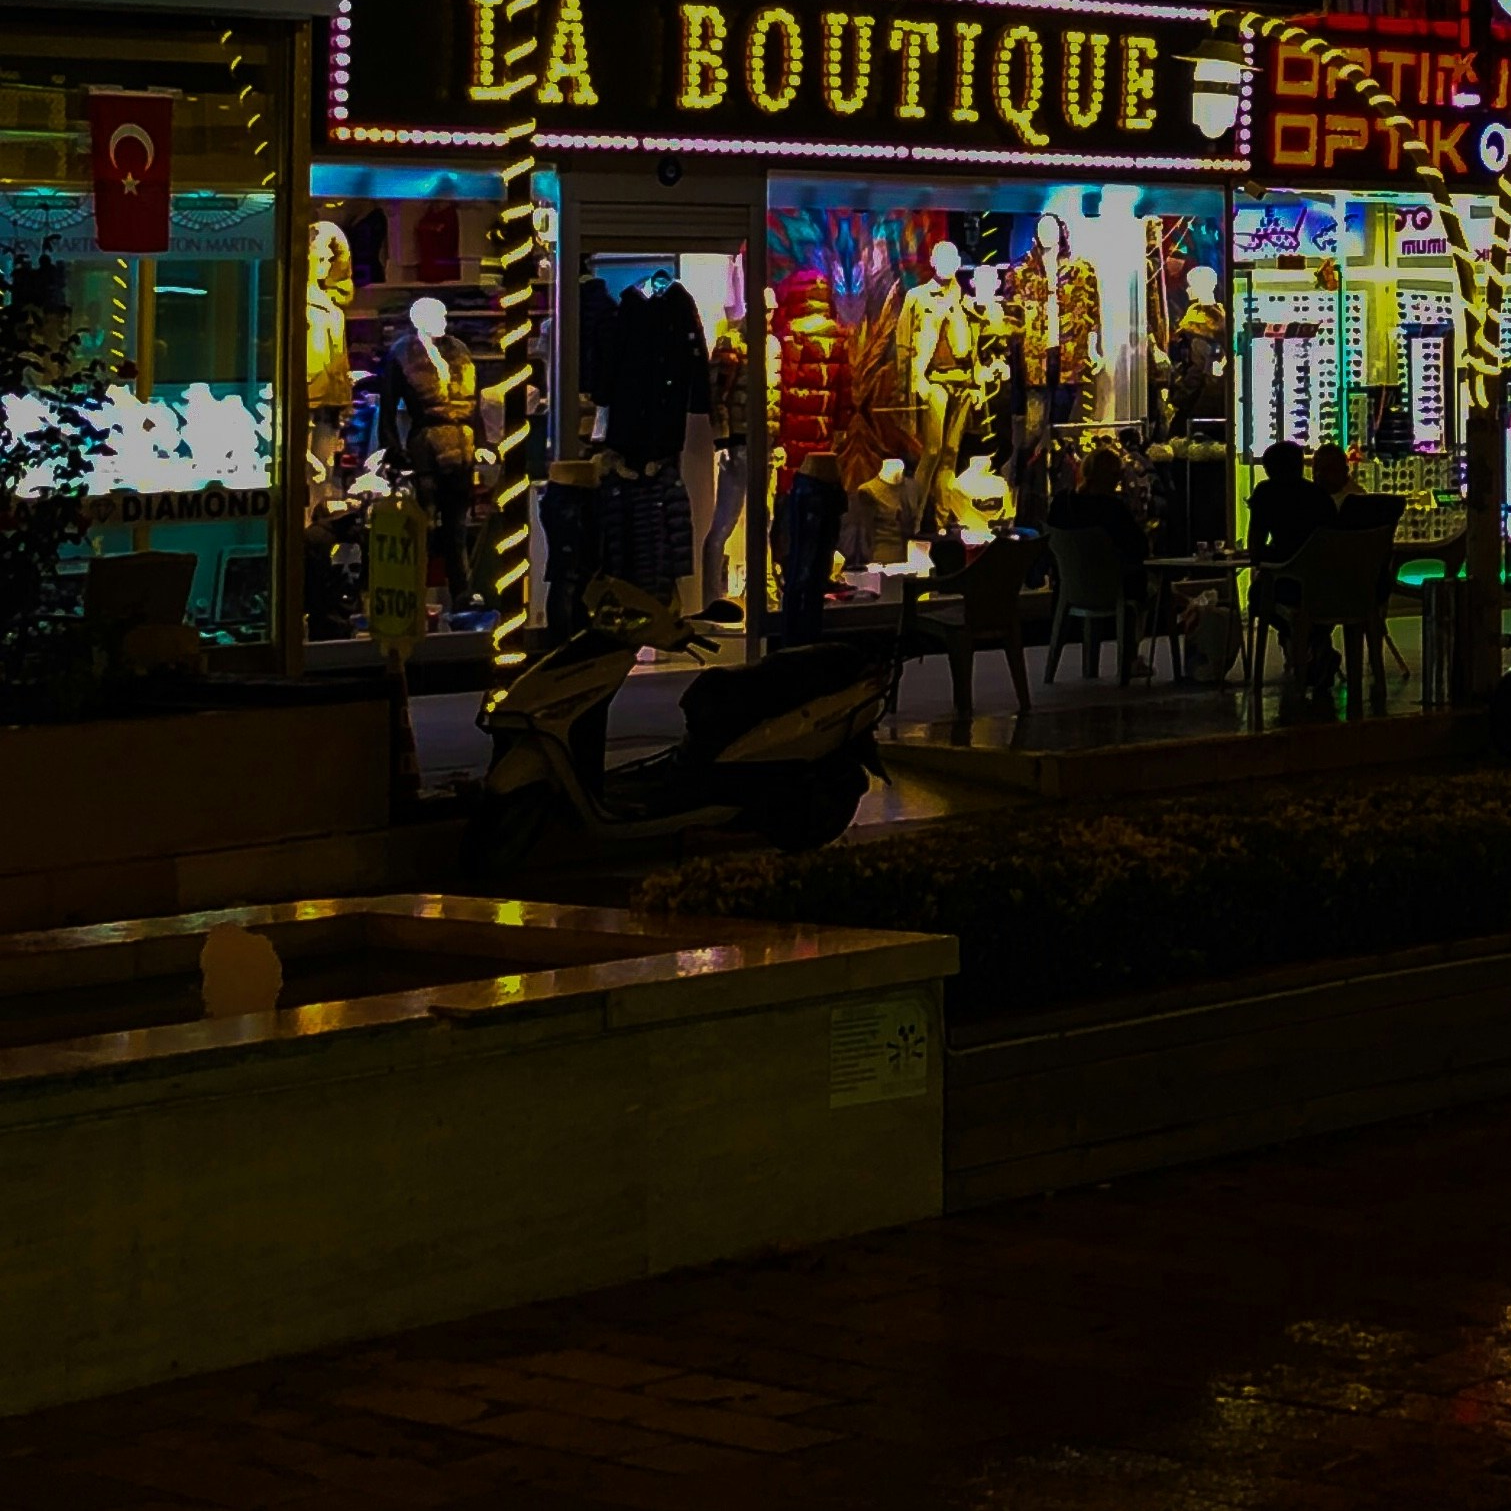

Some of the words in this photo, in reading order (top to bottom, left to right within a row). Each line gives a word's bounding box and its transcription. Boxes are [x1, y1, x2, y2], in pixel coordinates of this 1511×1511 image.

[676, 2, 1159, 145] BOUTIQUE
[1272, 112, 1471, 175] OPTIK
[122, 489, 271, 523] DIAMOND
[374, 586, 418, 619] STOP
